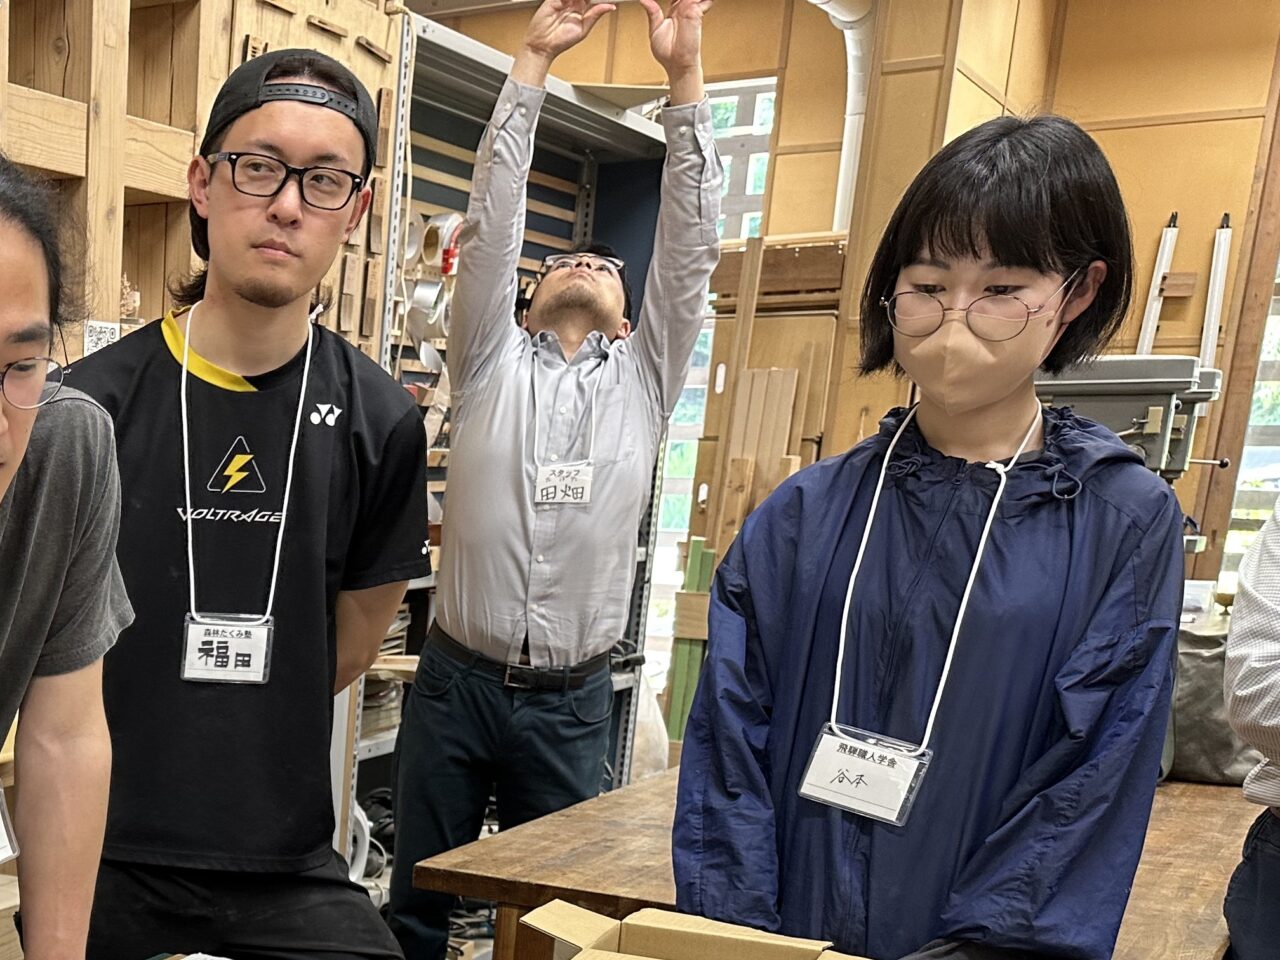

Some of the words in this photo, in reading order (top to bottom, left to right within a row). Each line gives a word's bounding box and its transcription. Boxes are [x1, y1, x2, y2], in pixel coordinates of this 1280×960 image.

[540, 483, 585, 501] 田畑
[176, 507, 286, 523] VOLTRAGE
[203, 628, 253, 639] 森林たくみ塾
[198, 640, 252, 669] 福田
[837, 742, 898, 769] 飛騨職人学舎
[830, 768, 869, 788] 谷本
